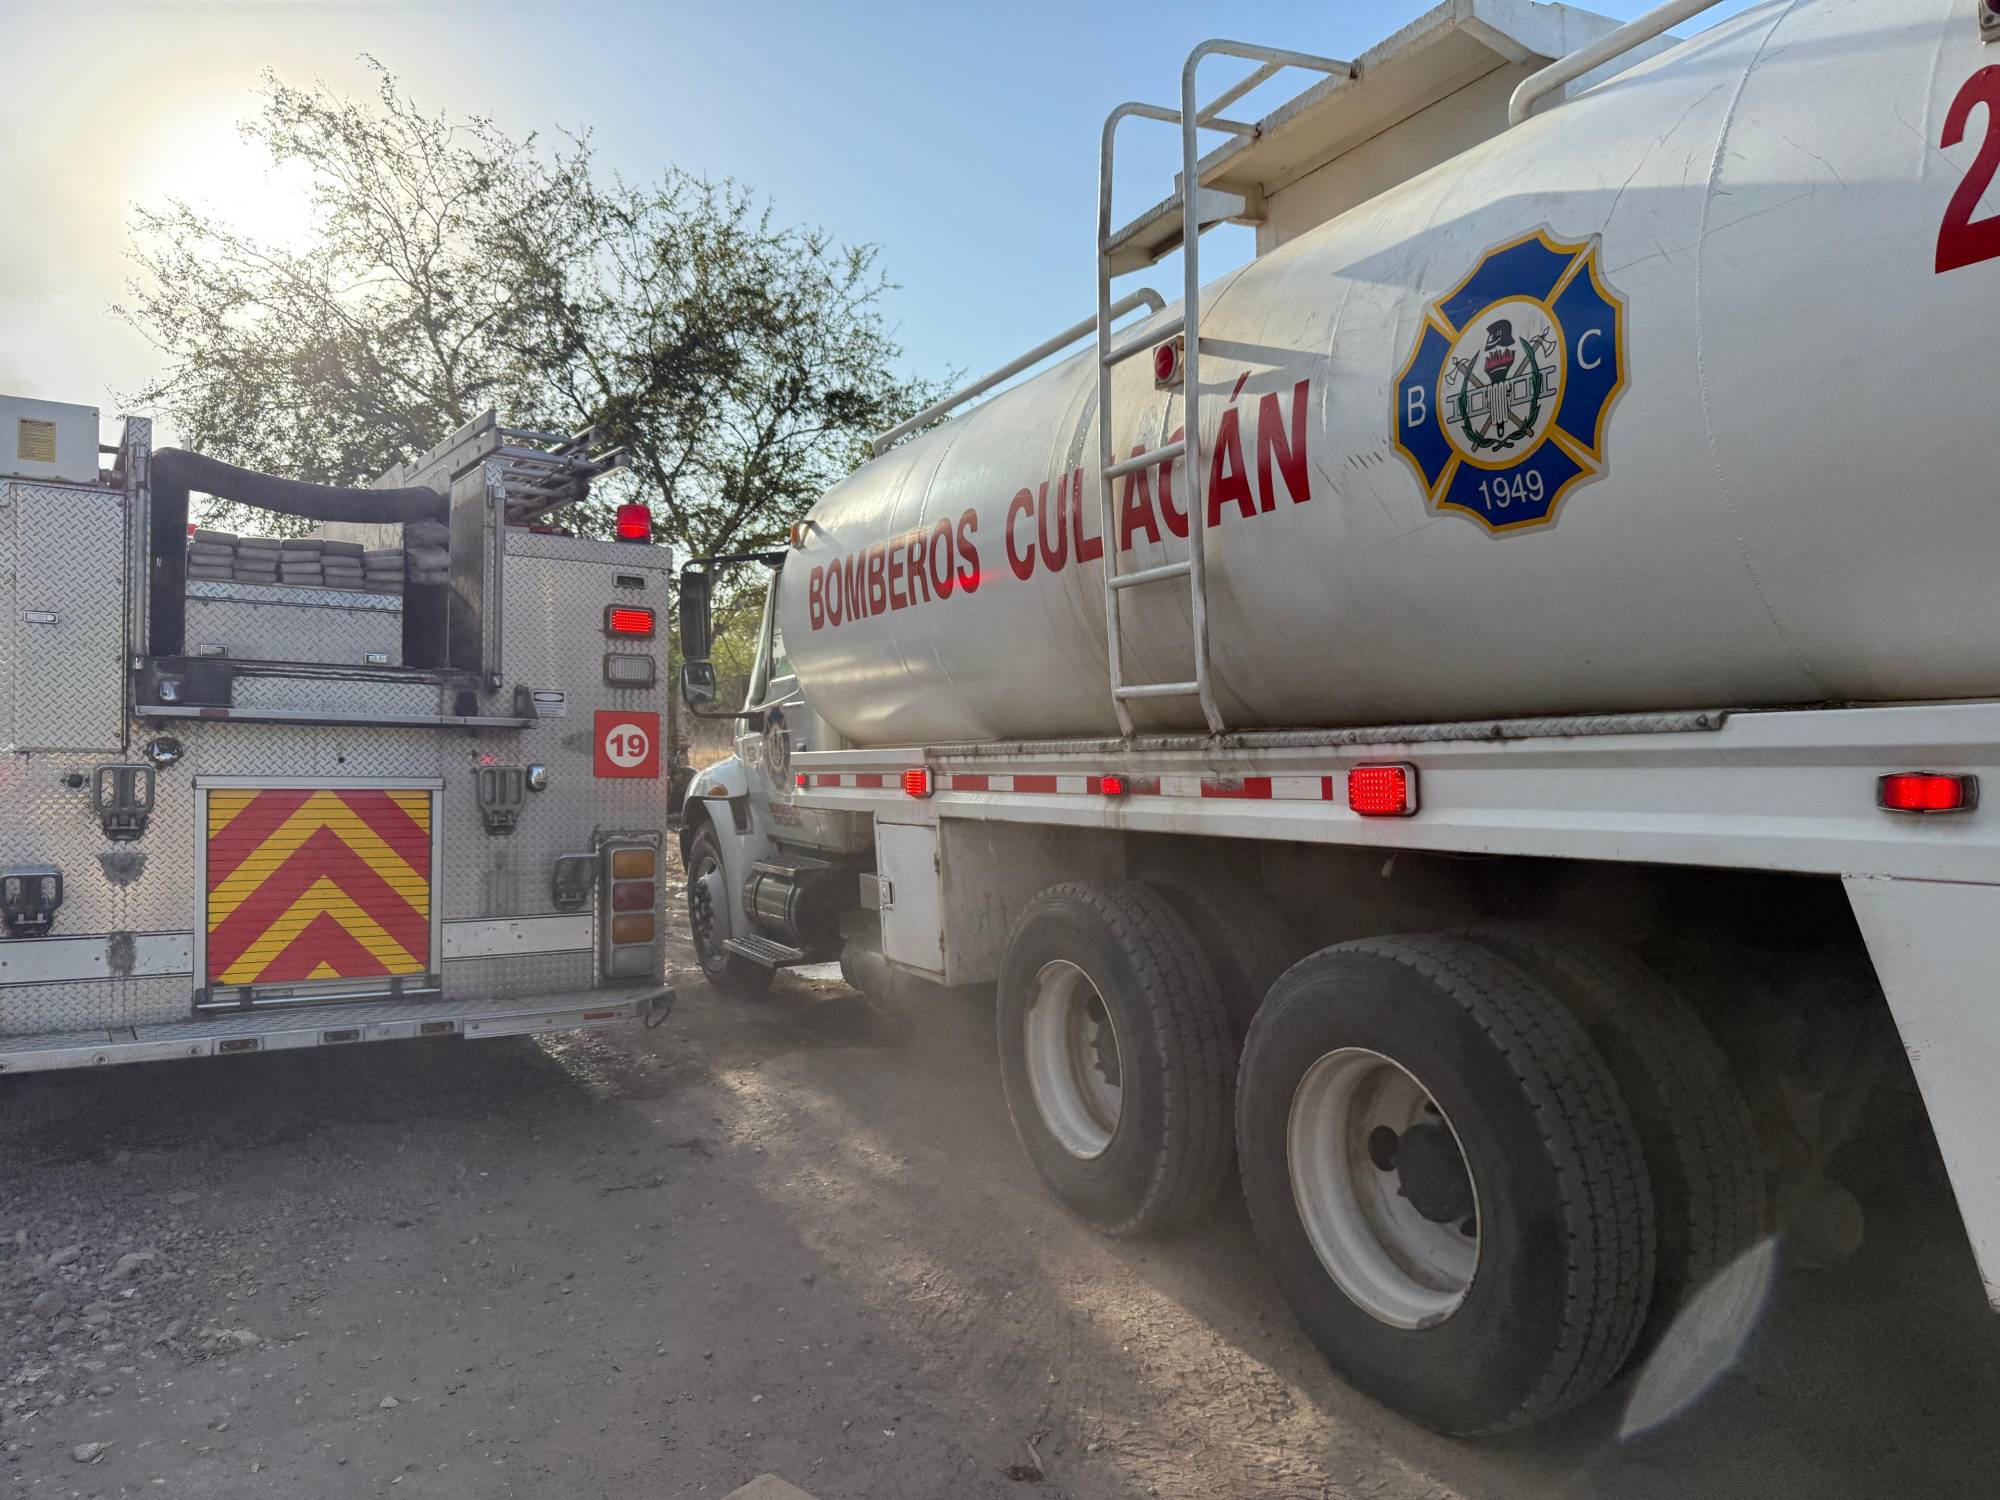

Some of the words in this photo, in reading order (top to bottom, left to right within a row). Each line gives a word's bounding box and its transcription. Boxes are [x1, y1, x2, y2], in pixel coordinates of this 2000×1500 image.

[1935, 64, 2000, 274] 2
[1576, 329, 1602, 370] C
[1407, 385, 1427, 428] B
[809, 508, 980, 630] BOMBEROS
[1006, 371, 1311, 580] CULACÁN
[1478, 469, 1544, 510] 1949
[610, 734, 645, 757] 19
